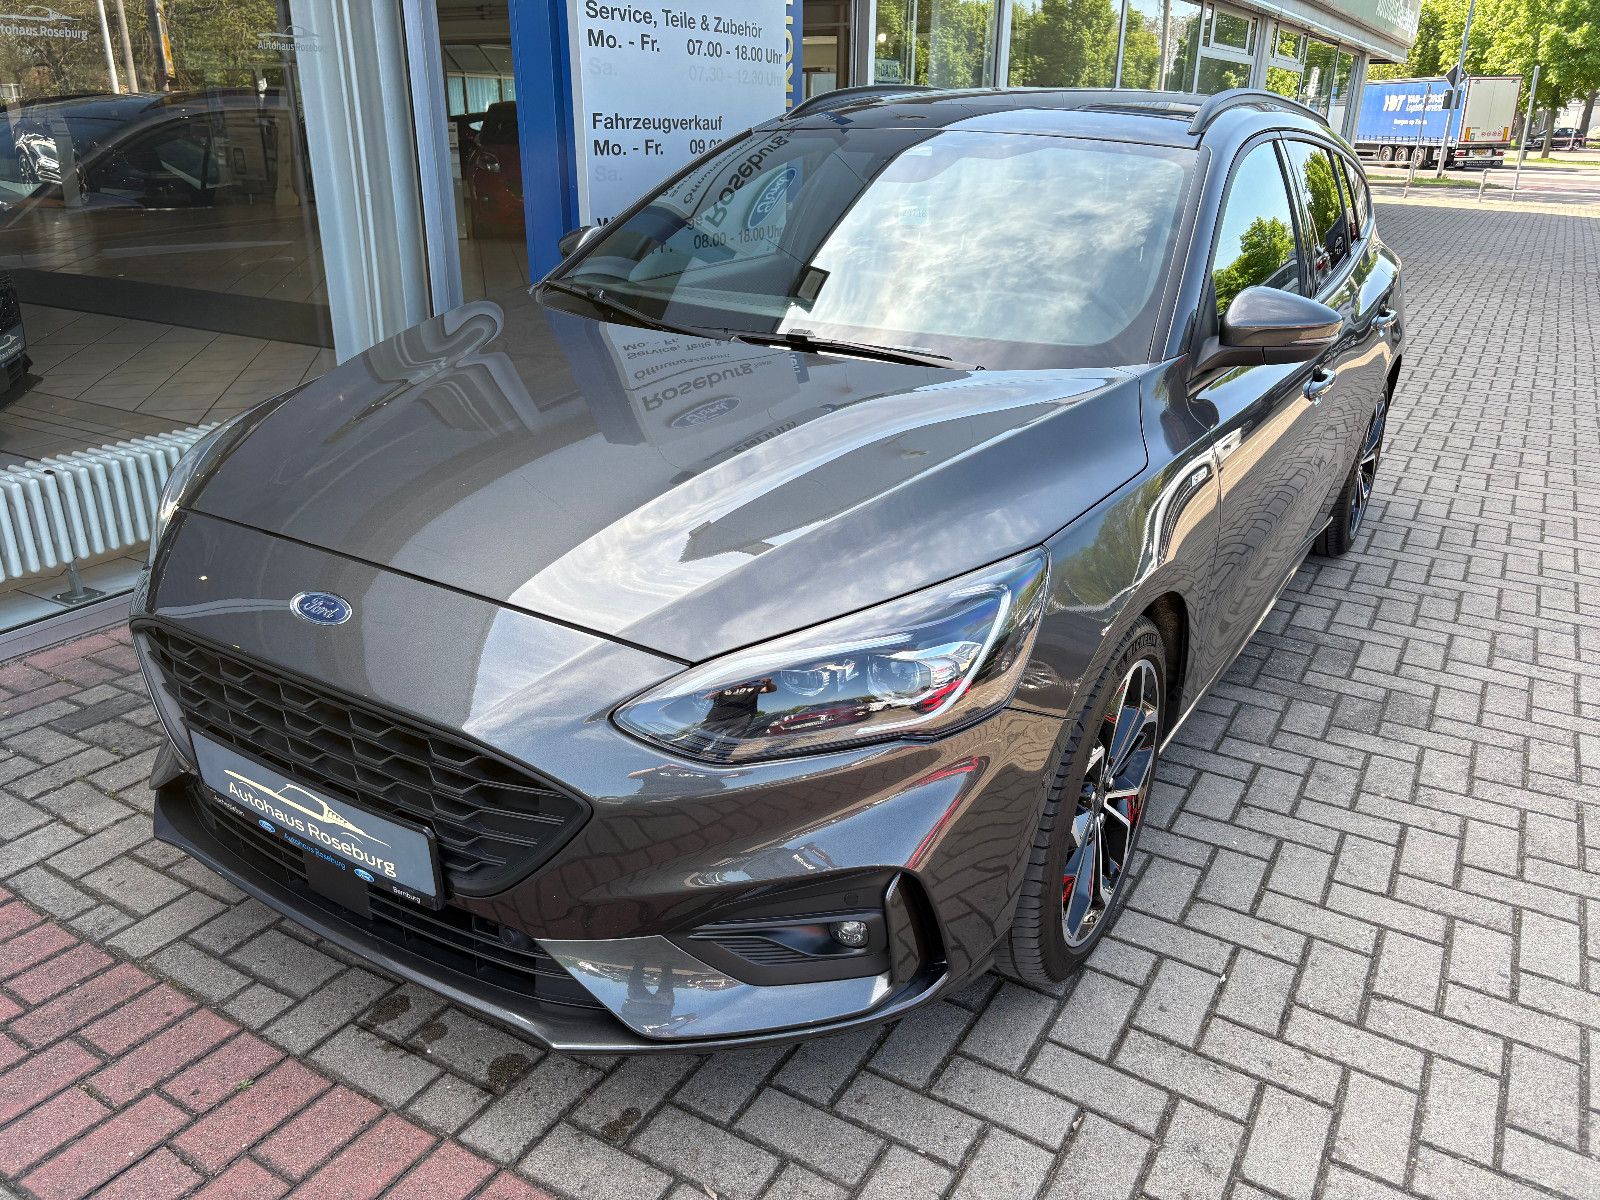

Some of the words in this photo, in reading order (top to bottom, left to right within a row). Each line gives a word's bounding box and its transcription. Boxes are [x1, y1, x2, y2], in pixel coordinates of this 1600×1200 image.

[585, 1, 658, 28] Service,
[662, 9, 696, 30] Teile
[700, 18, 710, 32] &
[713, 16, 762, 38] Zubehör
[40, 26, 88, 40] Roseburg
[257, 40, 295, 51] Autohaus
[587, 29, 622, 49] Mo.
[640, 34, 660, 52] Fr.
[686, 39, 722, 58] 07.00
[734, 45, 763, 62] 18.00
[765, 47, 783, 65] Uhr
[589, 57, 618, 77] Sa.
[688, 65, 724, 82] 07.30
[592, 112, 723, 135] Fahrzeugverkauf
[594, 139, 627, 156] Mo.
[645, 139, 664, 156] Fr.
[594, 166, 623, 183] Sa.
[694, 232, 726, 249] 08.00
[740, 227, 764, 243] 18.00
[229, 781, 304, 832] Autohaus
[308, 822, 397, 878] Roseburg
